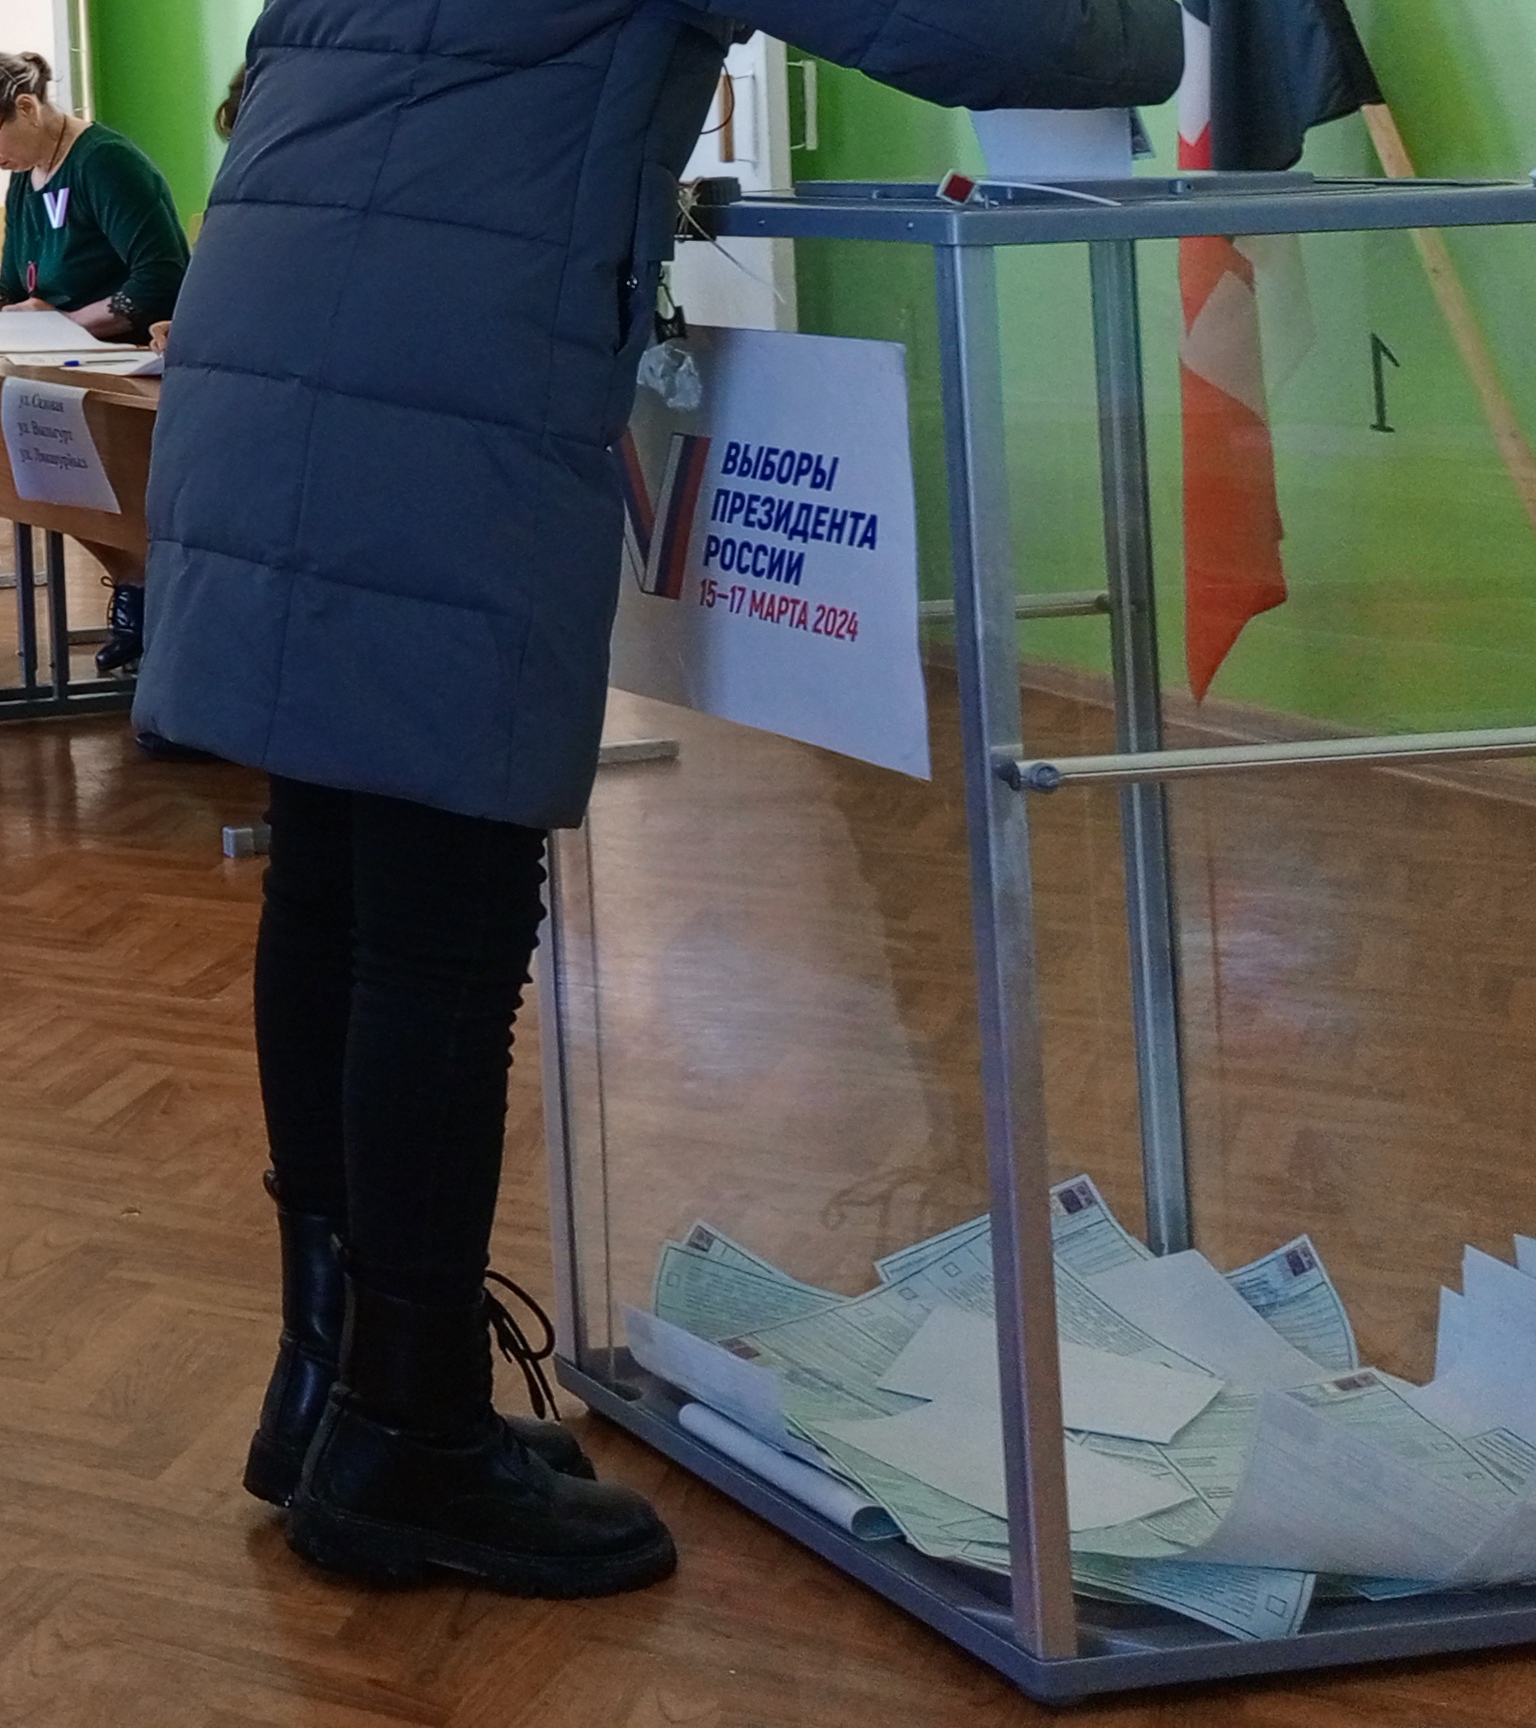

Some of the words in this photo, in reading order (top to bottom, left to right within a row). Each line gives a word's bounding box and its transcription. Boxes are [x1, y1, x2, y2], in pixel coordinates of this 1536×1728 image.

[720, 441, 840, 492] ВЫБОРЫ
[711, 488, 878, 551] ПРЕЗИДЕНТА
[702, 534, 806, 587] РОССИИ
[748, 589, 809, 632] МАРТА
[812, 603, 860, 643] 2024
